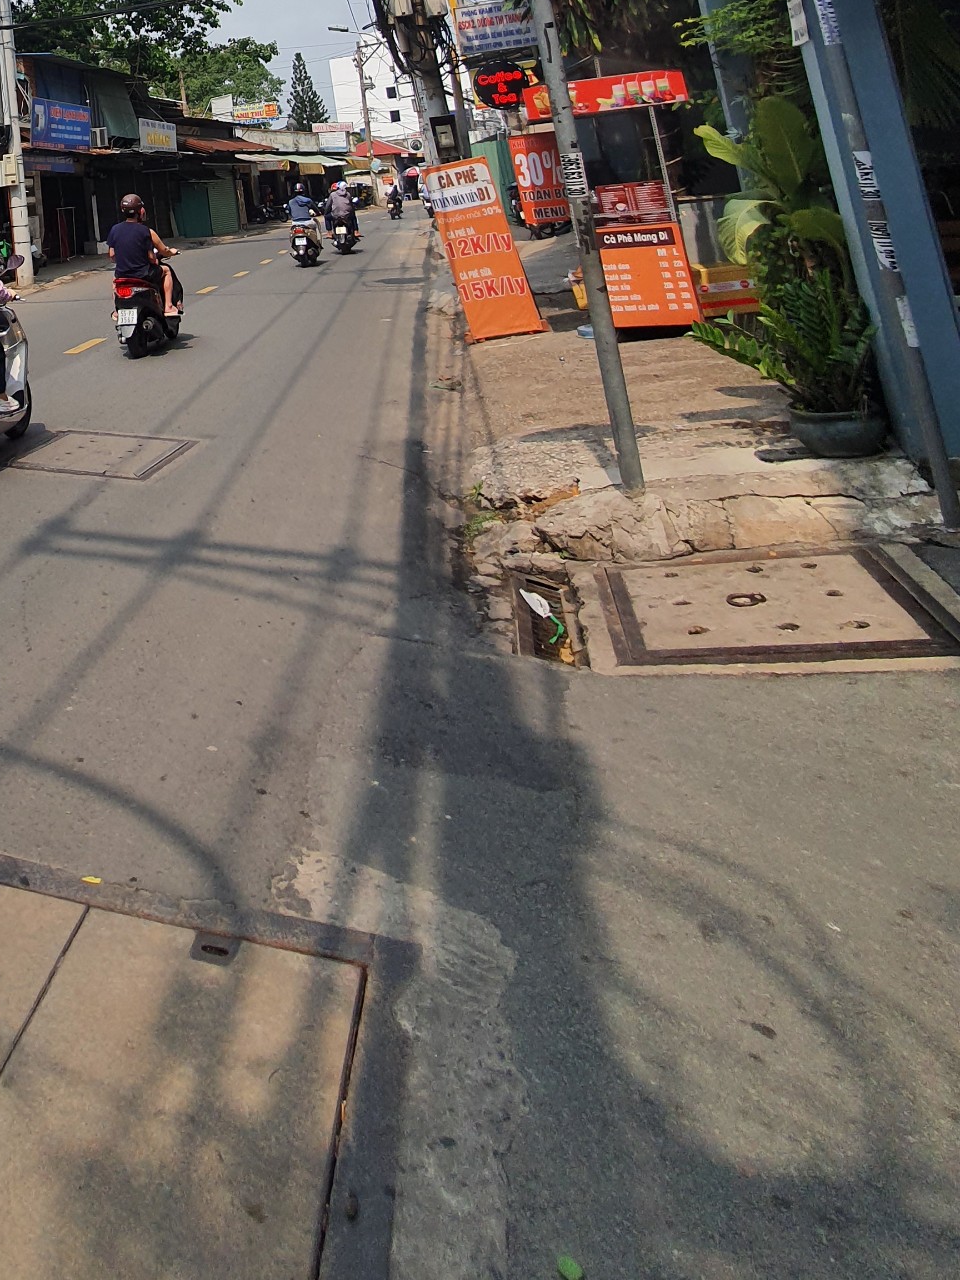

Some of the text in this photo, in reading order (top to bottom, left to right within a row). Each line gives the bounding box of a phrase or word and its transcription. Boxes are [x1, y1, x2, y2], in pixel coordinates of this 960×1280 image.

[478, 71, 522, 86] Coffee
[497, 82, 508, 93] &
[492, 93, 518, 105] Tea
[514, 150, 566, 188] 30%
[437, 165, 479, 189] CÀ PHÊ
[522, 186, 553, 202] TOÀN
[532, 205, 567, 220] MENU
[603, 233, 616, 244] Cà
[617, 231, 633, 243] Phê
[633, 231, 658, 244] Mang
[444, 231, 513, 260] 12K/ly
[656, 247, 679, 257] M L
[458, 275, 528, 303] 15K/ly
